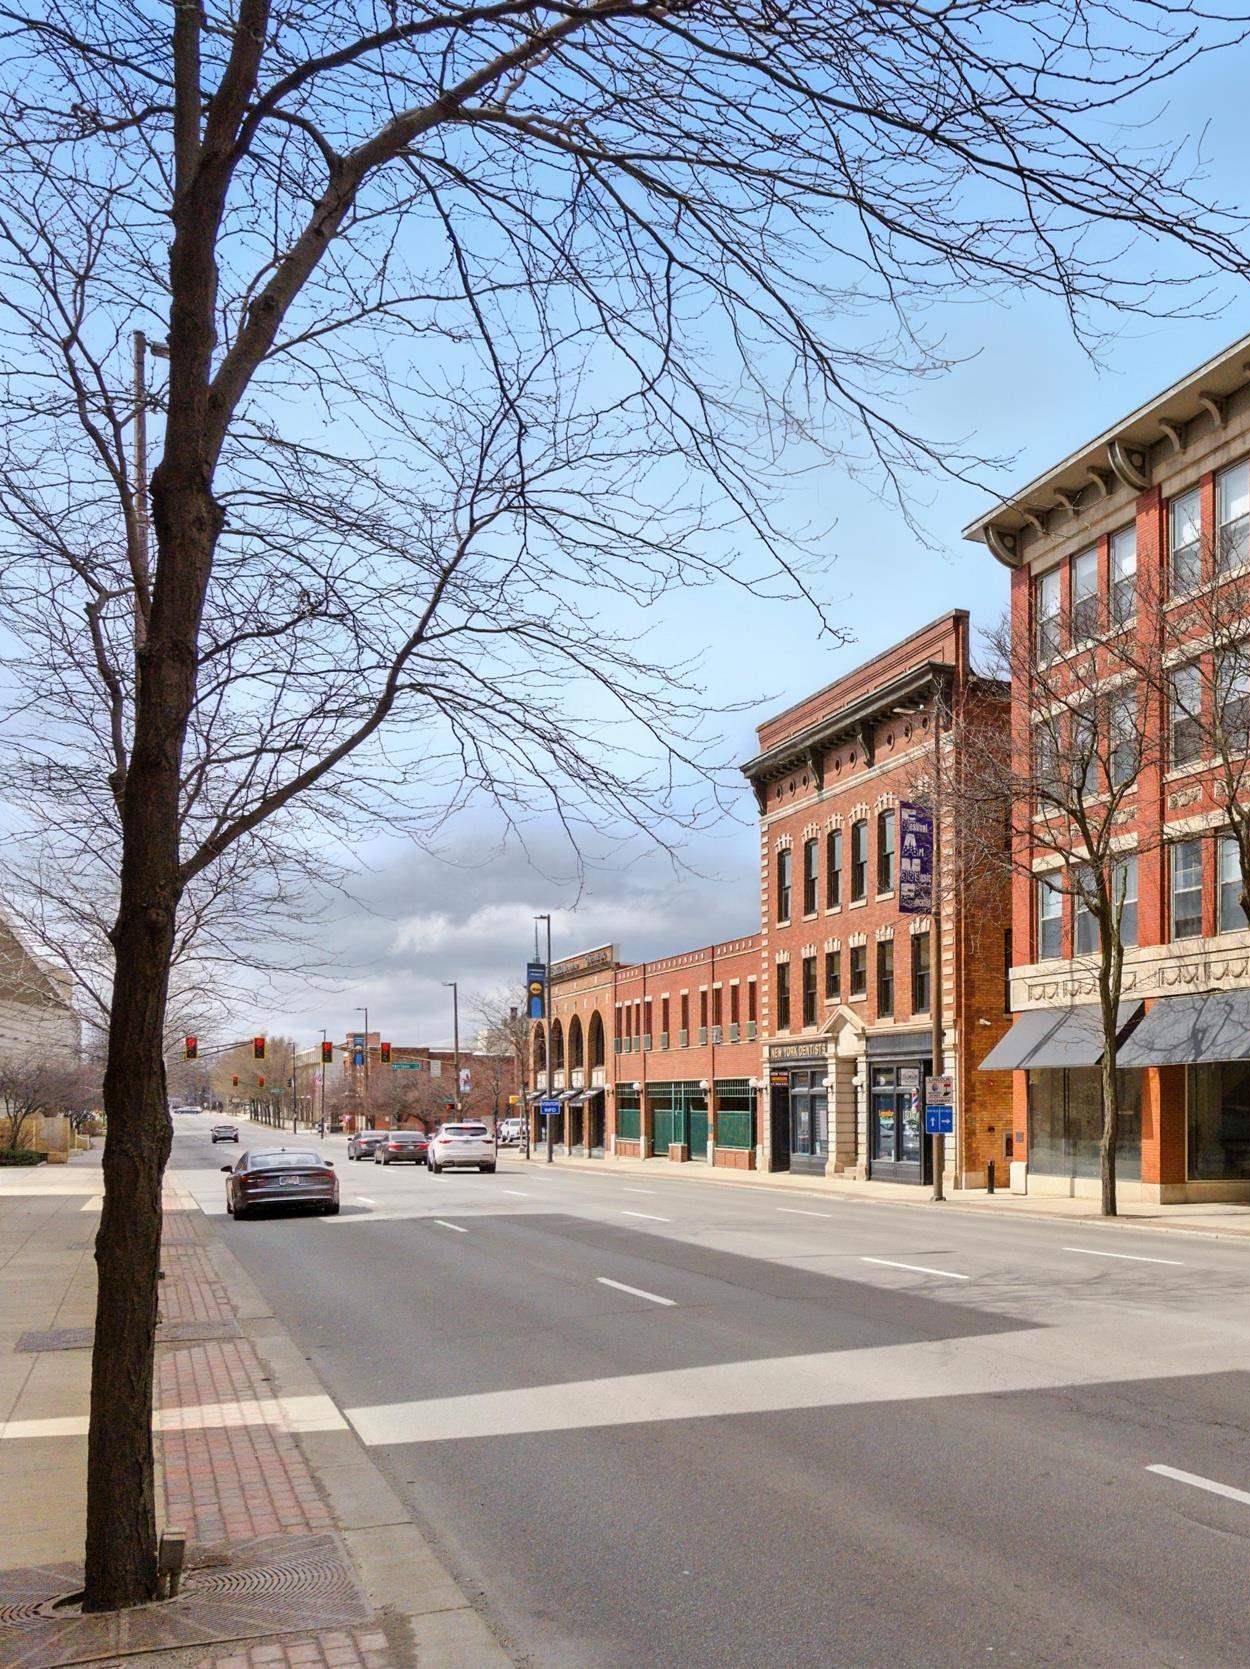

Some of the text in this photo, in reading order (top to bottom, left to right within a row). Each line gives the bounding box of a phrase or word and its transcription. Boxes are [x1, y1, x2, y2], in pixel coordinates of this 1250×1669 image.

[770, 1043, 826, 1059] NEW YORK DENTISTS
